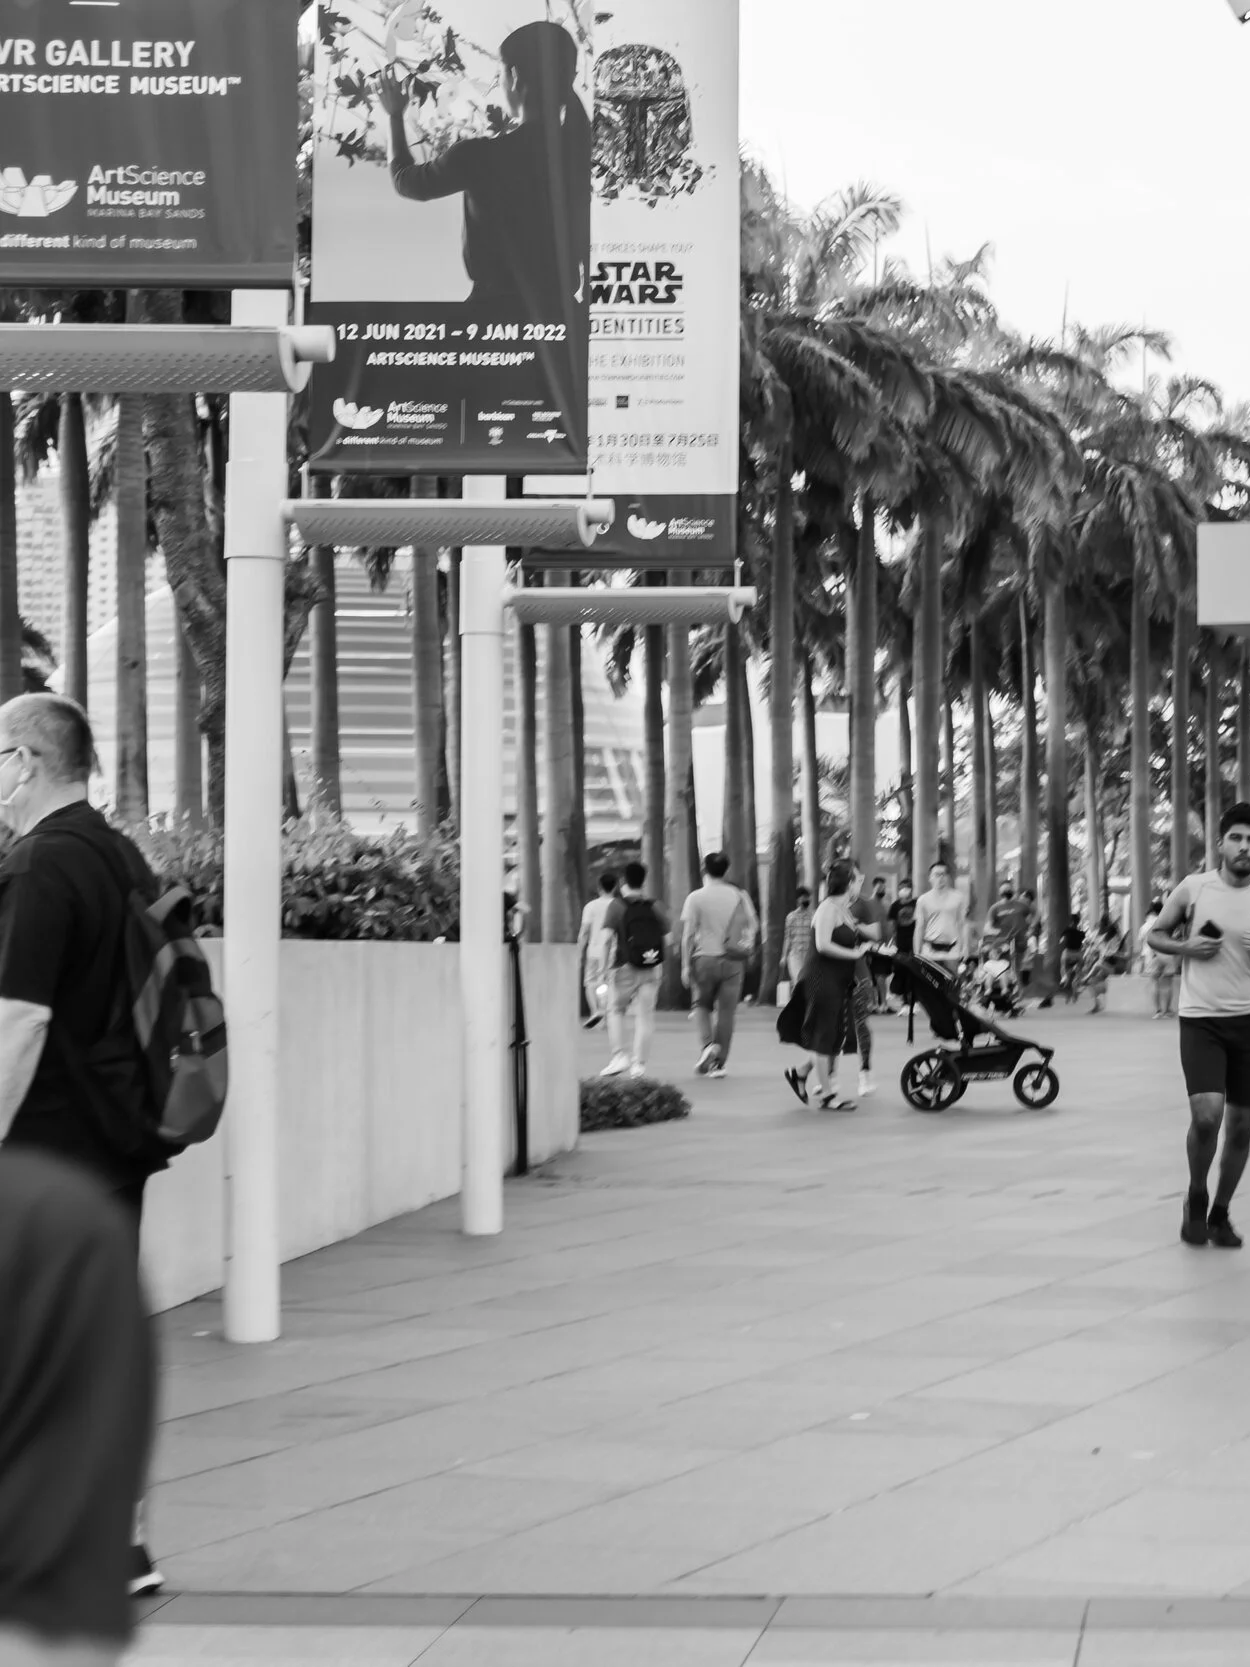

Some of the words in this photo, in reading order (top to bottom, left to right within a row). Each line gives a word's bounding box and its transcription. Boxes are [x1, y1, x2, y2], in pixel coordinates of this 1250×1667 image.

[0, 38, 37, 66] VR
[45, 39, 196, 68] GALLERY
[0, 73, 120, 94] RTSCIENCE
[87, 164, 206, 186] ArtScience
[86, 185, 180, 206] Museum
[86, 208, 136, 218] MARINA
[138, 208, 163, 218] BAY
[165, 208, 206, 219] SANDS
[0, 233, 70, 248] different
[72, 234, 107, 249] kind
[109, 234, 127, 249] of
[129, 238, 198, 249] museum
[590, 261, 683, 282] STAR
[591, 284, 683, 304] WARS
[336, 323, 359, 341] 12
[361, 323, 400, 341] JUN
[403, 323, 446, 341] 2021
[466, 323, 479, 341] 9
[481, 323, 519, 341] JAN
[522, 323, 567, 341] 2022
[590, 318, 685, 335] DENTITIES
[366, 351, 457, 366] ARTSCIENCE
[589, 354, 607, 368] HE
[610, 354, 685, 368] EXHIBITION
[387, 400, 448, 413] ArtScience
[386, 412, 435, 423] Museum
[589, 433, 719, 448] 1月30日至7月25日
